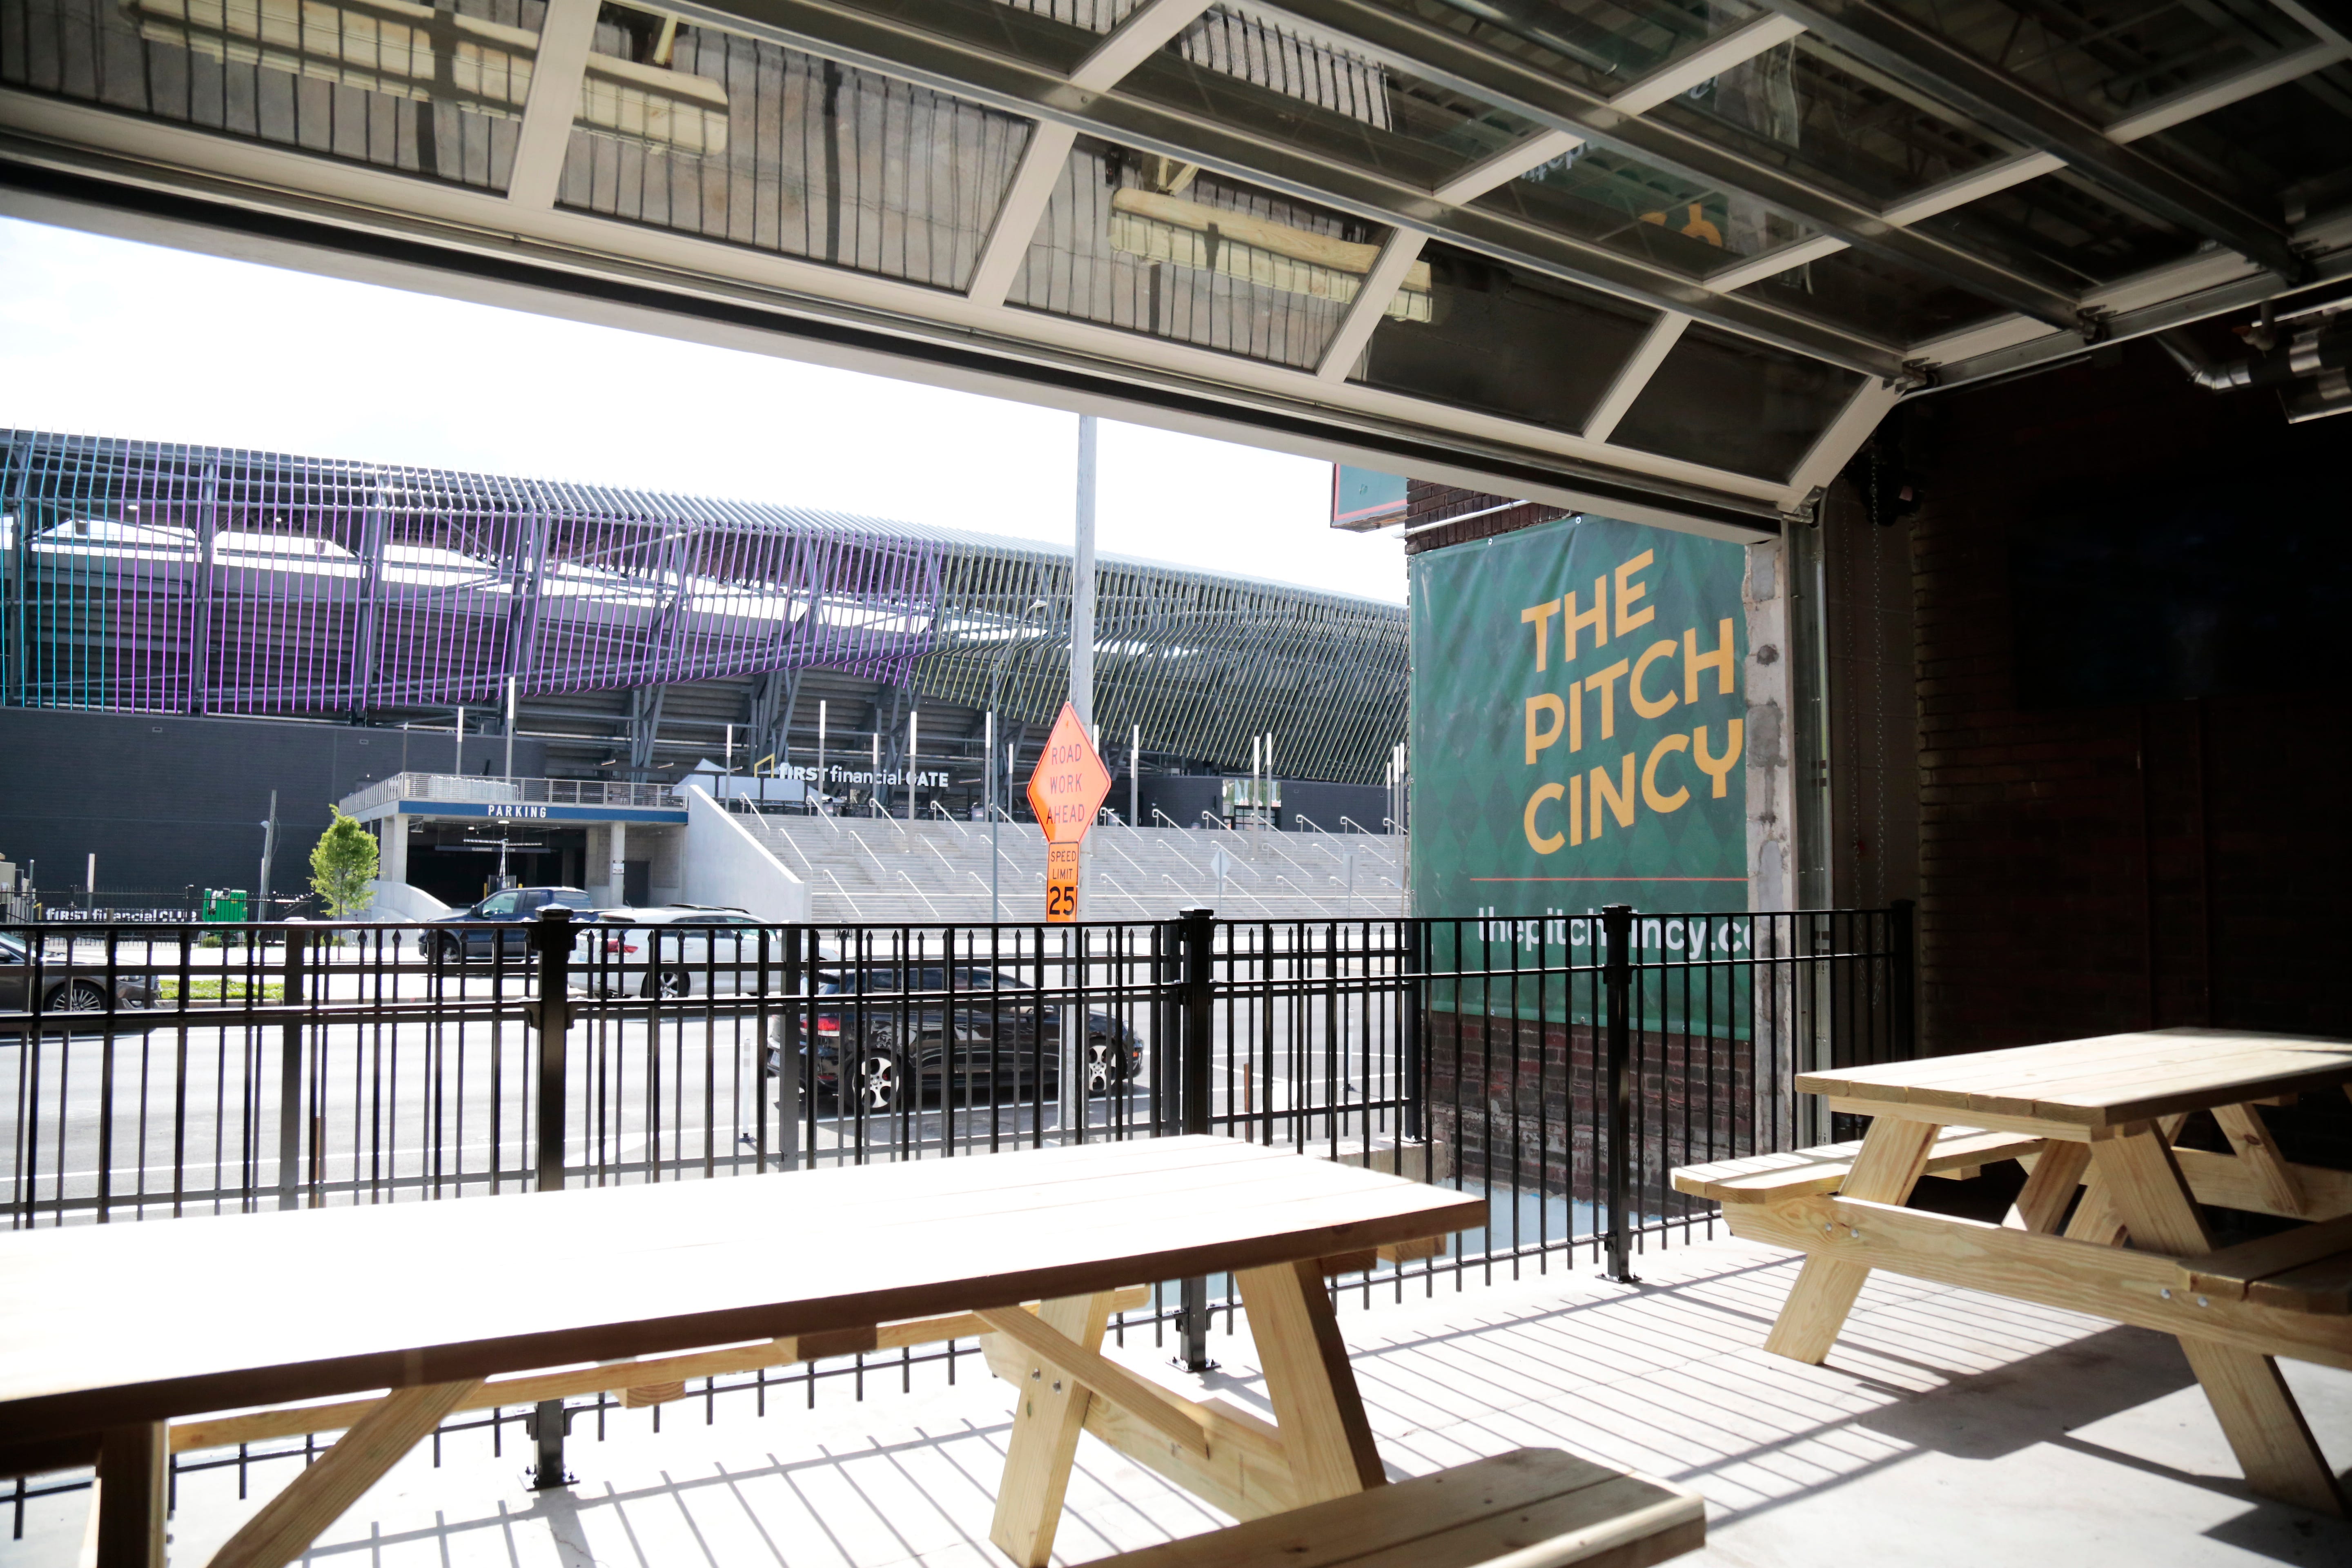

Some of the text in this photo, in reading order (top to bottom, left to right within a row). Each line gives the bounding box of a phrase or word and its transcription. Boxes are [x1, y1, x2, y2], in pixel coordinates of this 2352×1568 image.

[1521, 549, 1655, 672] THE
[1525, 618, 1734, 764] PITCH
[1051, 744, 1082, 765] ROAD
[830, 765, 902, 785] financial
[906, 771, 949, 787] GATE
[1050, 773, 1082, 794] WORK
[1524, 719, 1743, 854] CINCY
[488, 805, 546, 818] PARKING
[1046, 804, 1085, 824] AHEAD
[1051, 851, 1076, 862] SPEED
[1052, 868, 1073, 880] LIMIT
[1049, 886, 1075, 916] 25
[1477, 906, 1750, 960] thepitchincy.c
